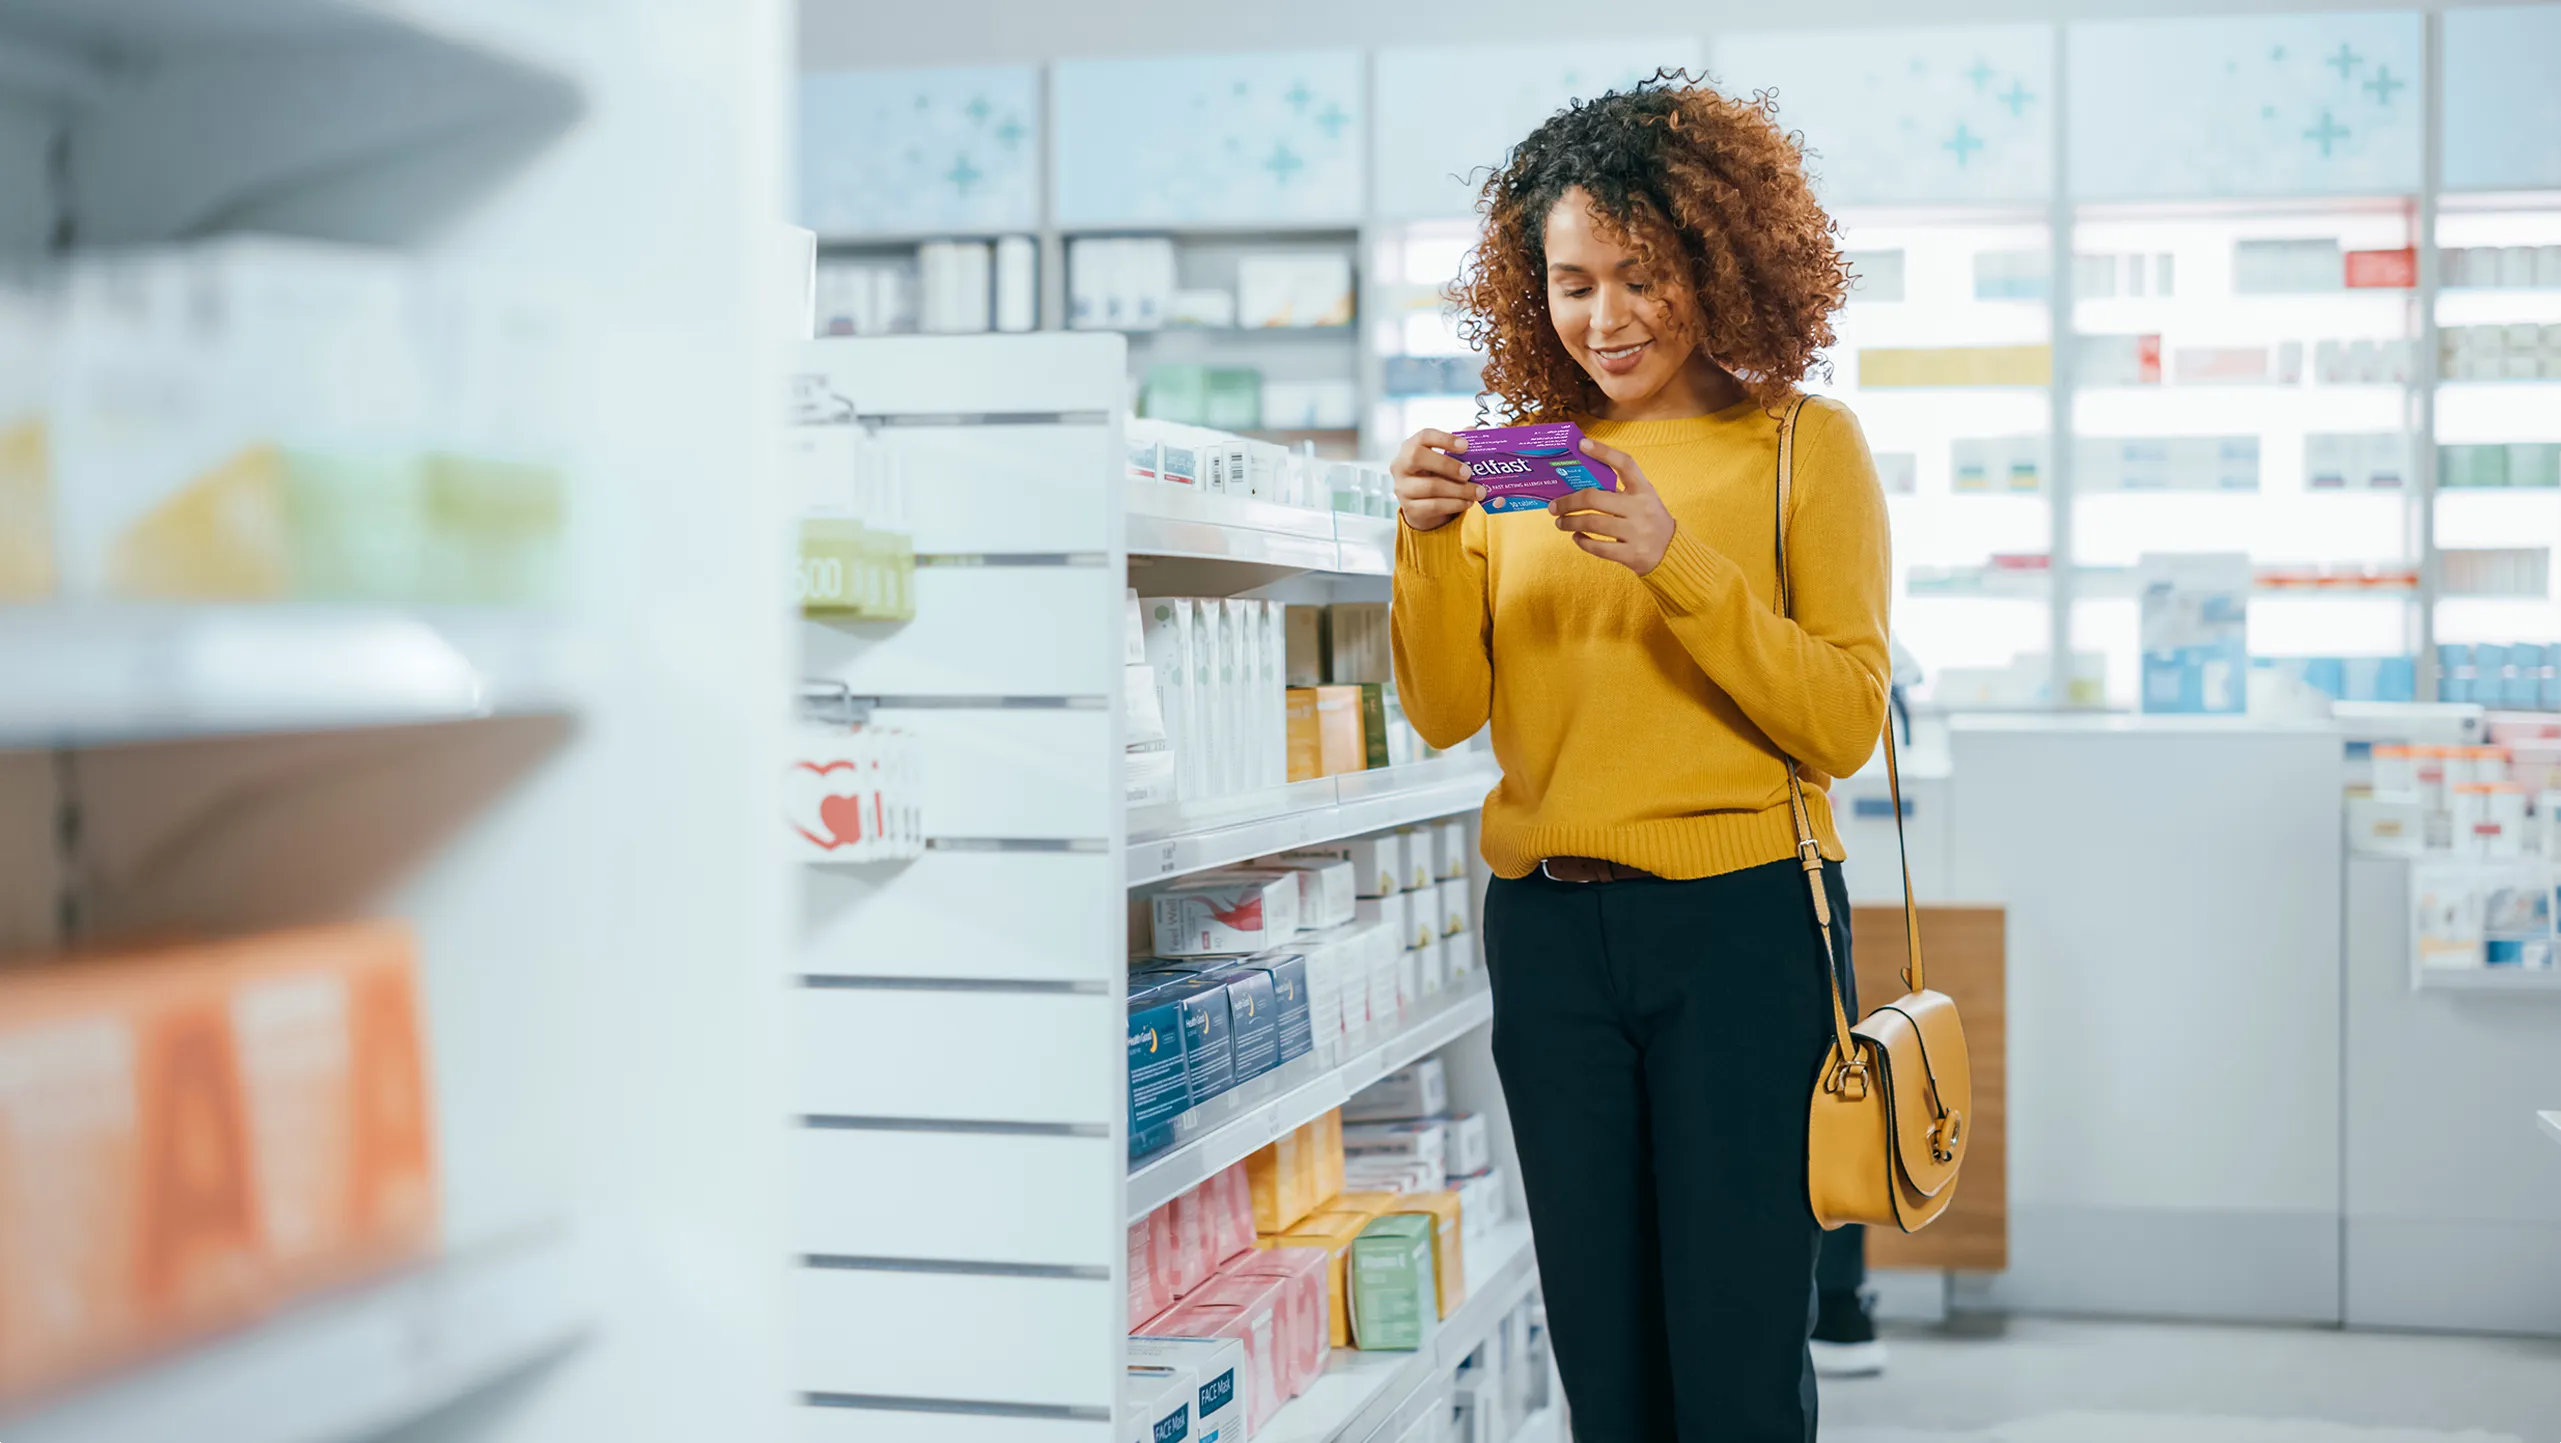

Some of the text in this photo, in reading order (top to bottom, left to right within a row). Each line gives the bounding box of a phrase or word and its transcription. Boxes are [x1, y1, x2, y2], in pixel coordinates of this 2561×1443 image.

[1201, 1375, 1231, 1406] FACE Mask
[1155, 1419, 1172, 1443] FACE
[1171, 1410, 1186, 1433] Mask
